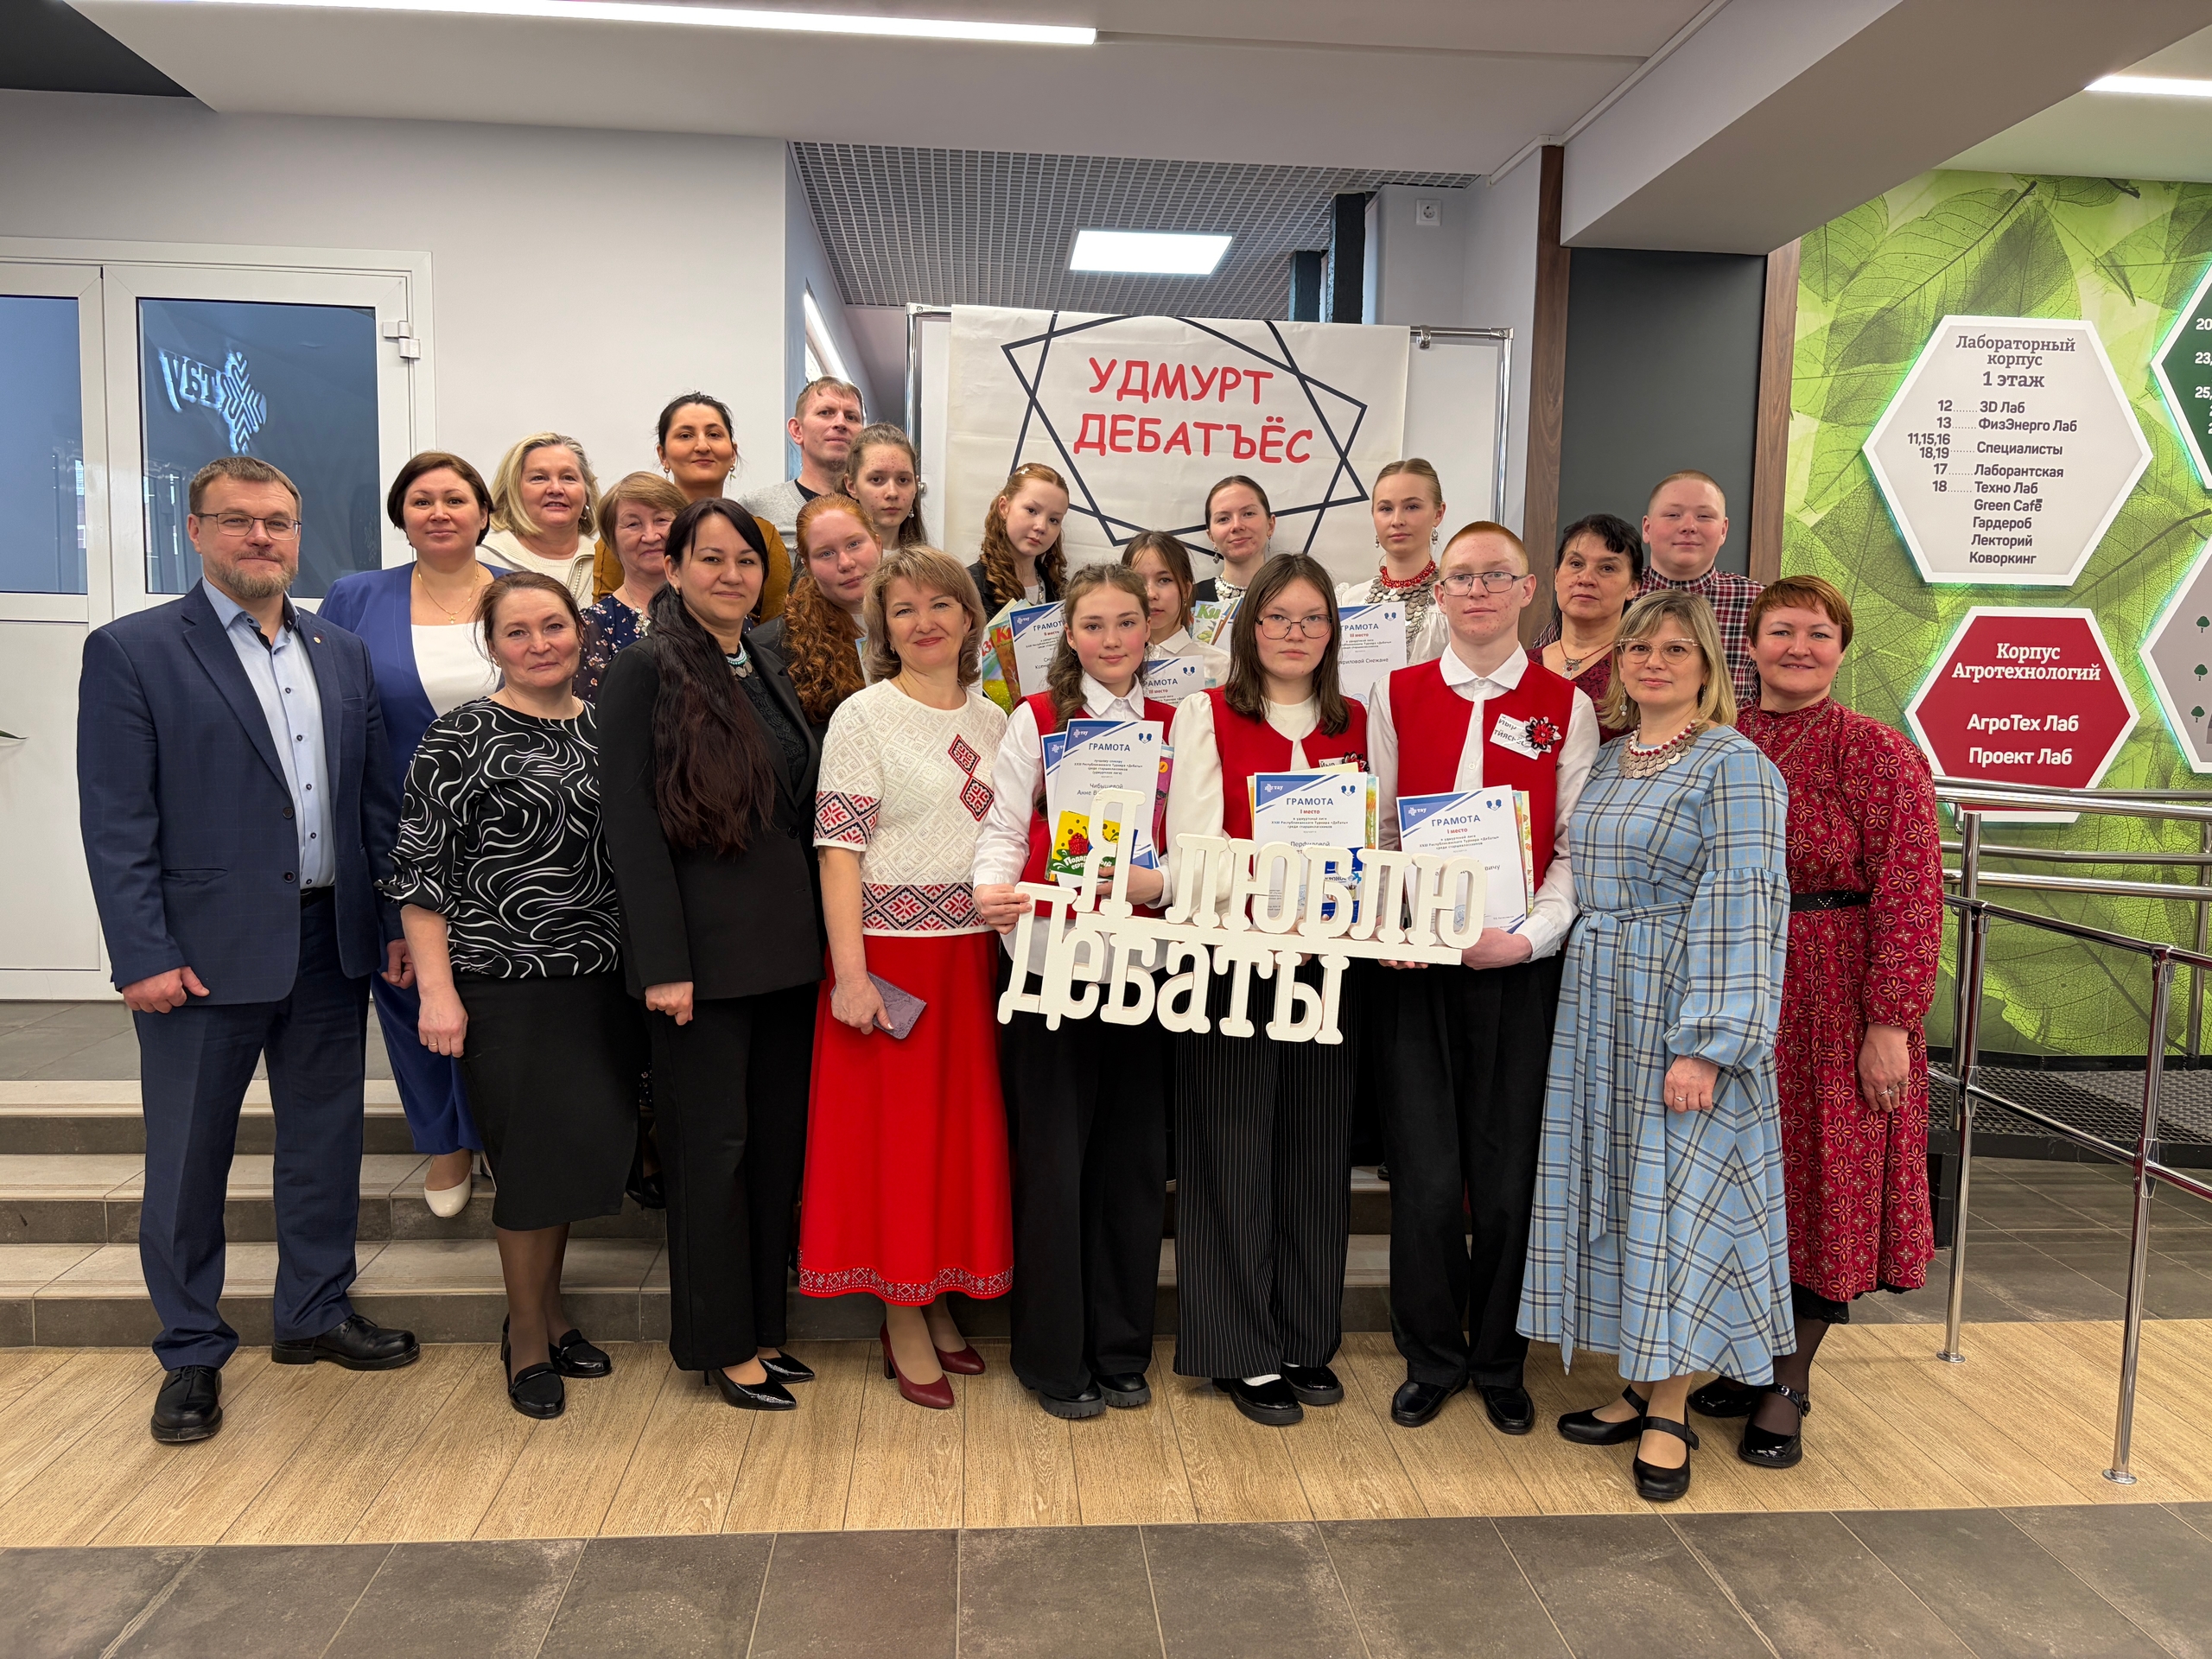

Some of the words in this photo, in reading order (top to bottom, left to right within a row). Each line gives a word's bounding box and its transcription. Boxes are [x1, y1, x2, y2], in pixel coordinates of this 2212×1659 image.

[1956, 334, 2075, 353] Лабораторный
[1987, 354, 2043, 369] корпус
[1089, 356, 1274, 405] УДМУРТ
[1983, 372, 1992, 385] 1
[1997, 374, 2044, 387] этаж
[1937, 400, 1953, 411] 12
[1980, 401, 1998, 413] 3D
[2000, 402, 2025, 413] Лаб
[1936, 416, 1952, 429] 13
[1979, 417, 2050, 434] ФизЭнерго
[2052, 420, 2077, 432] Лаб
[1073, 413, 1313, 464] ДЕБАТЪЁС
[1907, 433, 1950, 446] 11,15,16
[1919, 447, 1949, 460] 18,19
[1977, 442, 2063, 455] Специалисты
[1934, 463, 1948, 474] 17
[1974, 464, 2064, 479] Лаборантская
[1932, 480, 1948, 492] 18
[1974, 481, 2011, 493] Техно
[2013, 482, 2038, 493] Лаб
[1974, 499, 2011, 511] Green
[1973, 517, 2031, 531] Гардероб
[1971, 534, 2033, 549] Лекторий
[1969, 551, 2037, 566] Коворкинг
[1996, 642, 2061, 664] Корпус
[1952, 663, 2101, 683] Агротехнологий
[1967, 714, 2041, 735] АгроТех
[2043, 715, 2080, 732] Лаб
[1088, 742, 1131, 752] ГРАМОТА
[1968, 747, 2034, 768] Проект
[2037, 748, 2073, 766] Лаб
[1432, 815, 1481, 827] ГРАМОТА
[1072, 787, 1146, 918] Я
